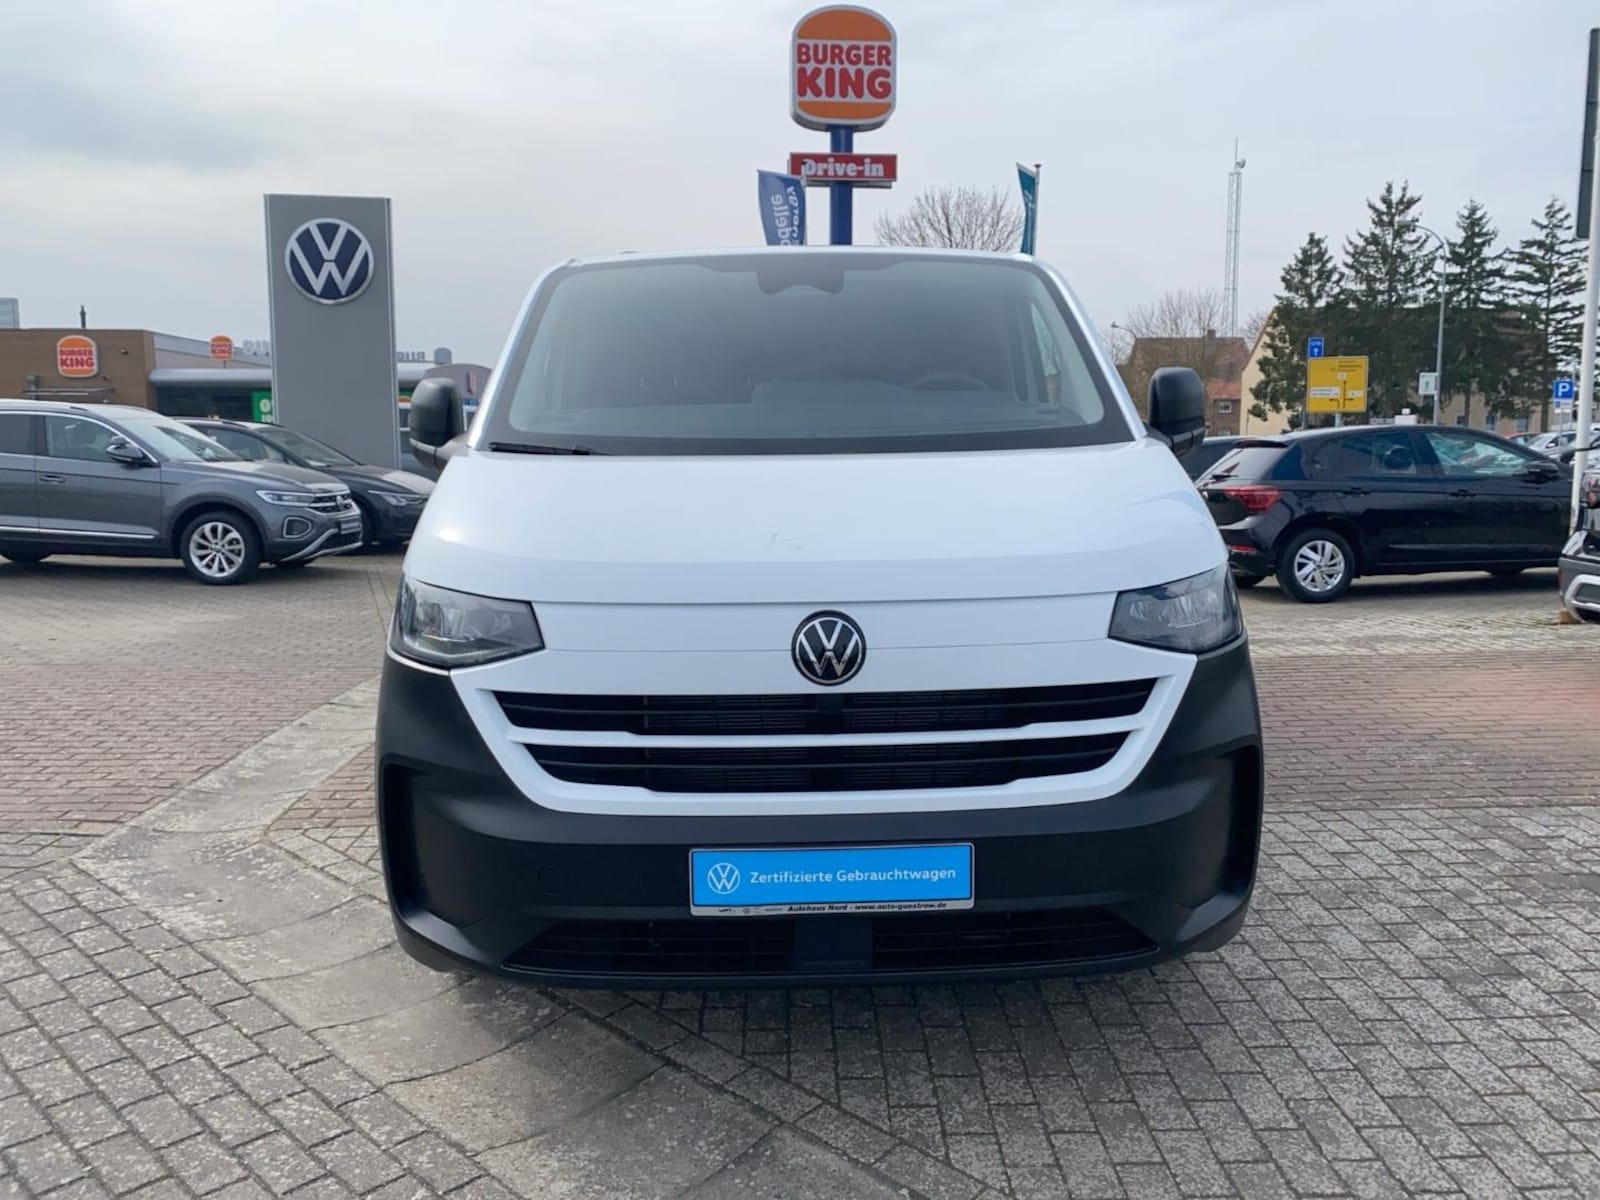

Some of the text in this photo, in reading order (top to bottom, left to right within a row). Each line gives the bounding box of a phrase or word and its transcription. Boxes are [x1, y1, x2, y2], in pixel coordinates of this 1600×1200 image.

[797, 43, 892, 66] BURGER
[797, 66, 892, 99] KING
[802, 158, 885, 177] Drive-in
[60, 357, 94, 368] KING
[1558, 383, 1570, 397] P
[750, 867, 956, 884] Zertifizierte Gebrauchtwagen
[787, 904, 826, 913] Autohaus
[828, 903, 848, 911] Nord
